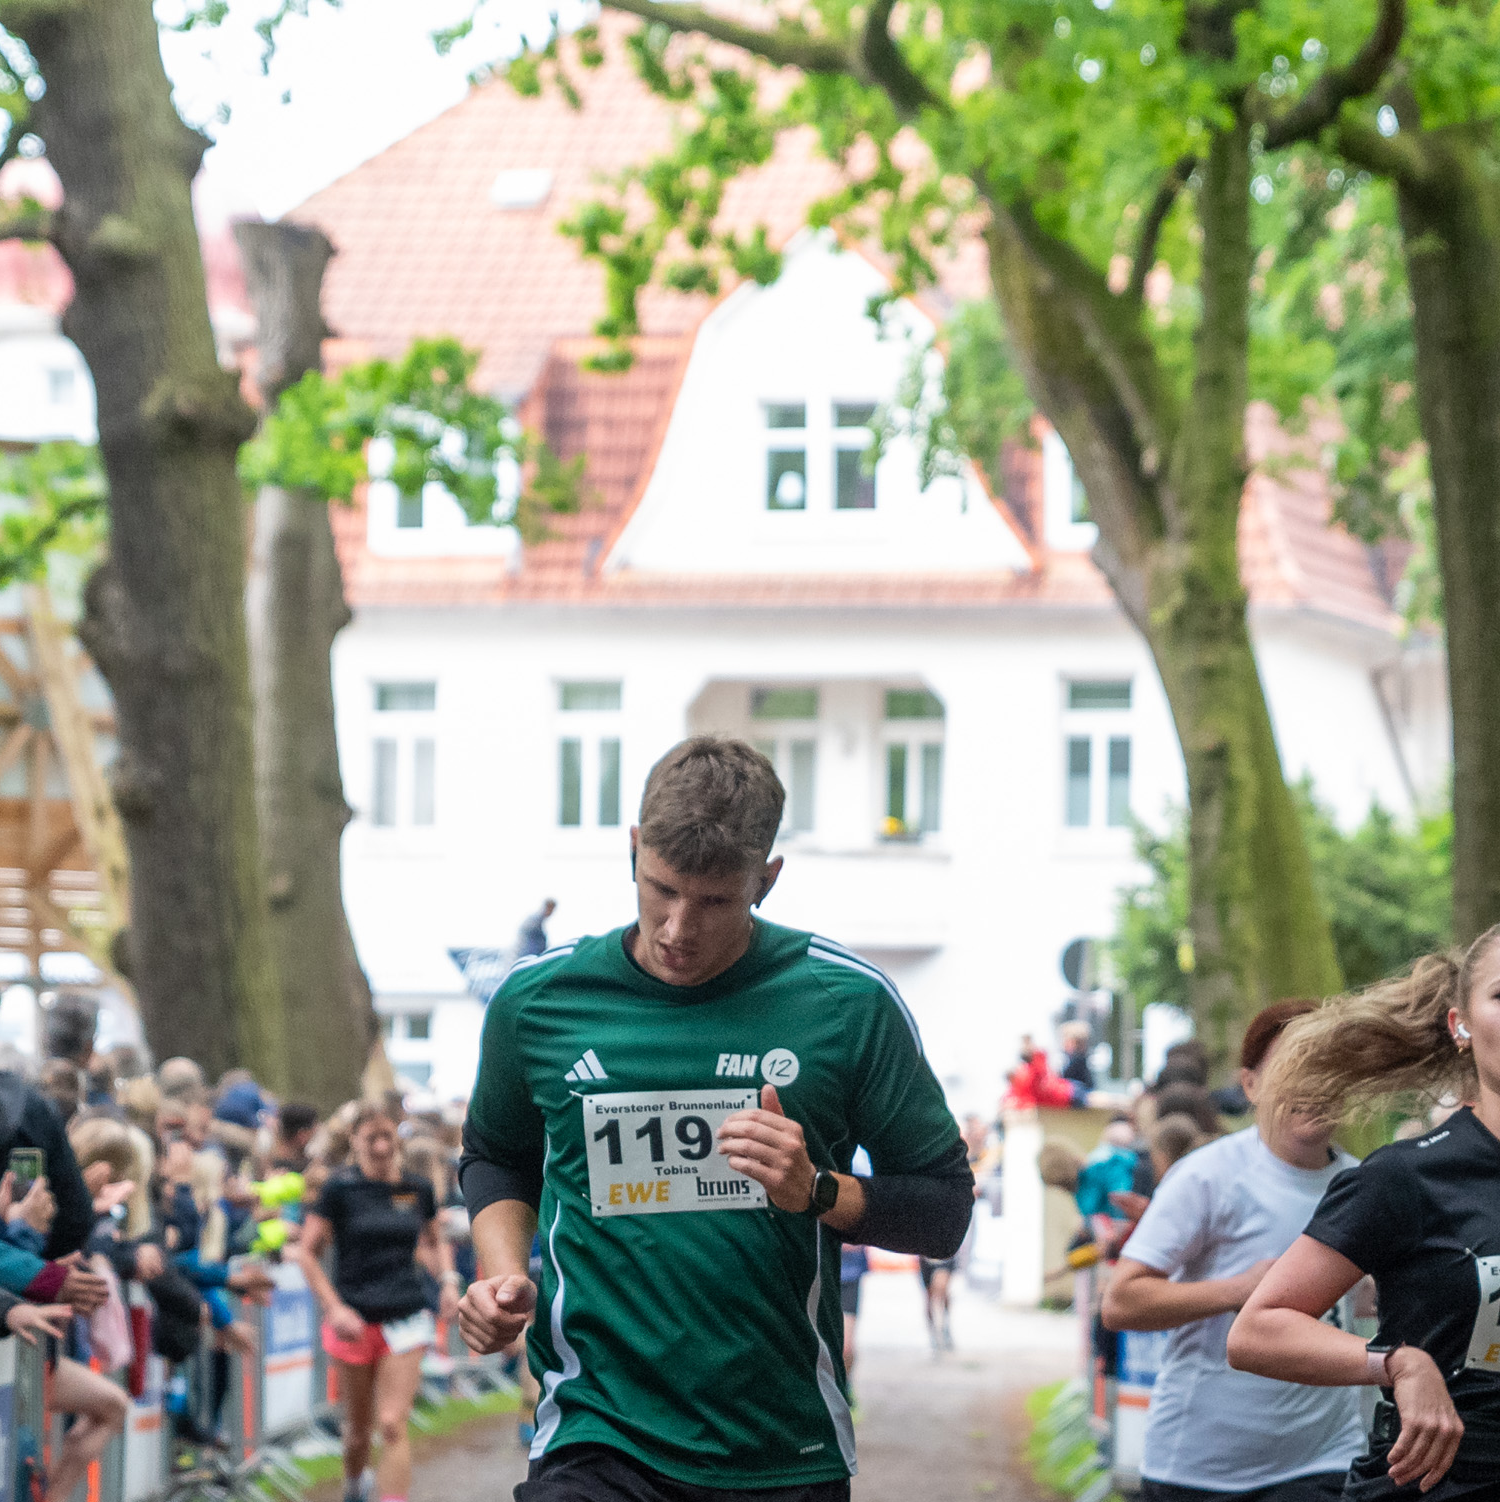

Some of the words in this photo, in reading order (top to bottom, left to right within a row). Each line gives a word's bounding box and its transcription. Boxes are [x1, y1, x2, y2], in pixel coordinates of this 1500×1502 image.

[715, 1053, 758, 1077] FAN
[769, 1058, 793, 1077] 12
[595, 1103, 664, 1115] Everstener
[669, 1100, 746, 1111] Brunnenlauf
[593, 1115, 713, 1165] 119
[654, 1165, 698, 1176] Tobias
[608, 1180, 670, 1206] EWE
[696, 1176, 750, 1197] bruns
